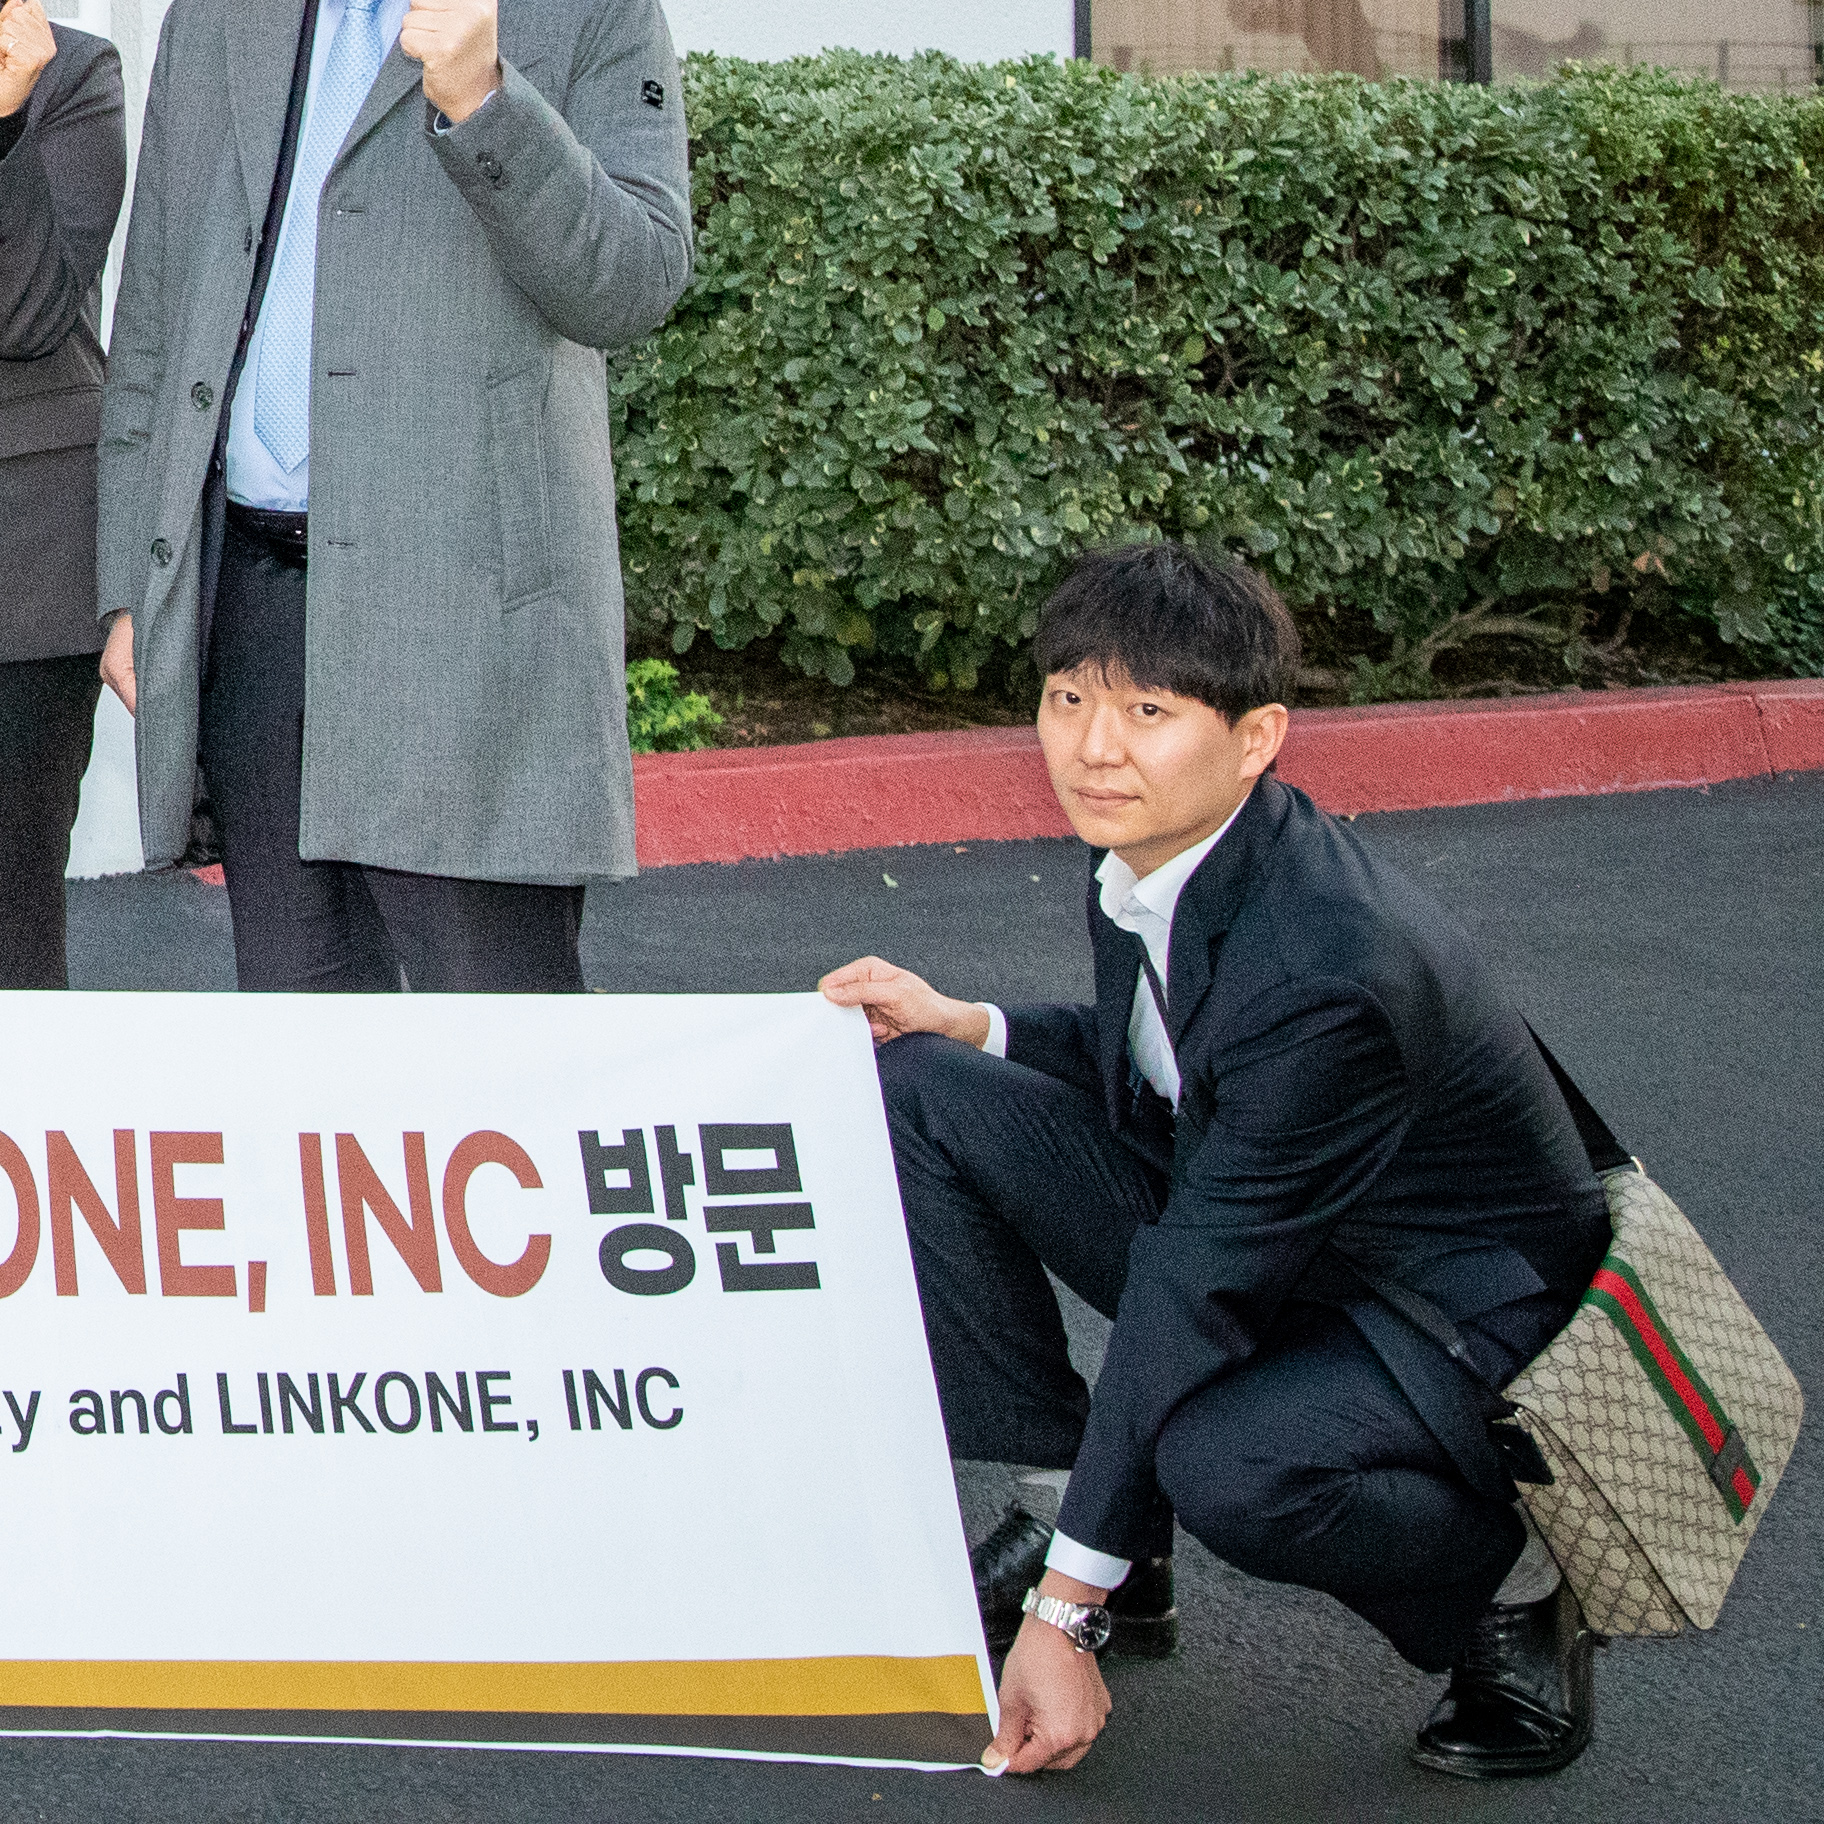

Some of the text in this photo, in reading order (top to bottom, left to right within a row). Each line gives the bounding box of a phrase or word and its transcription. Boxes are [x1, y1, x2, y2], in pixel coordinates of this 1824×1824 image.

[299, 1130, 552, 1298] INC
[578, 1123, 822, 1297] 방문
[69, 1373, 193, 1435] and
[216, 1371, 539, 1442] LINKONE,
[562, 1367, 684, 1431] INC
